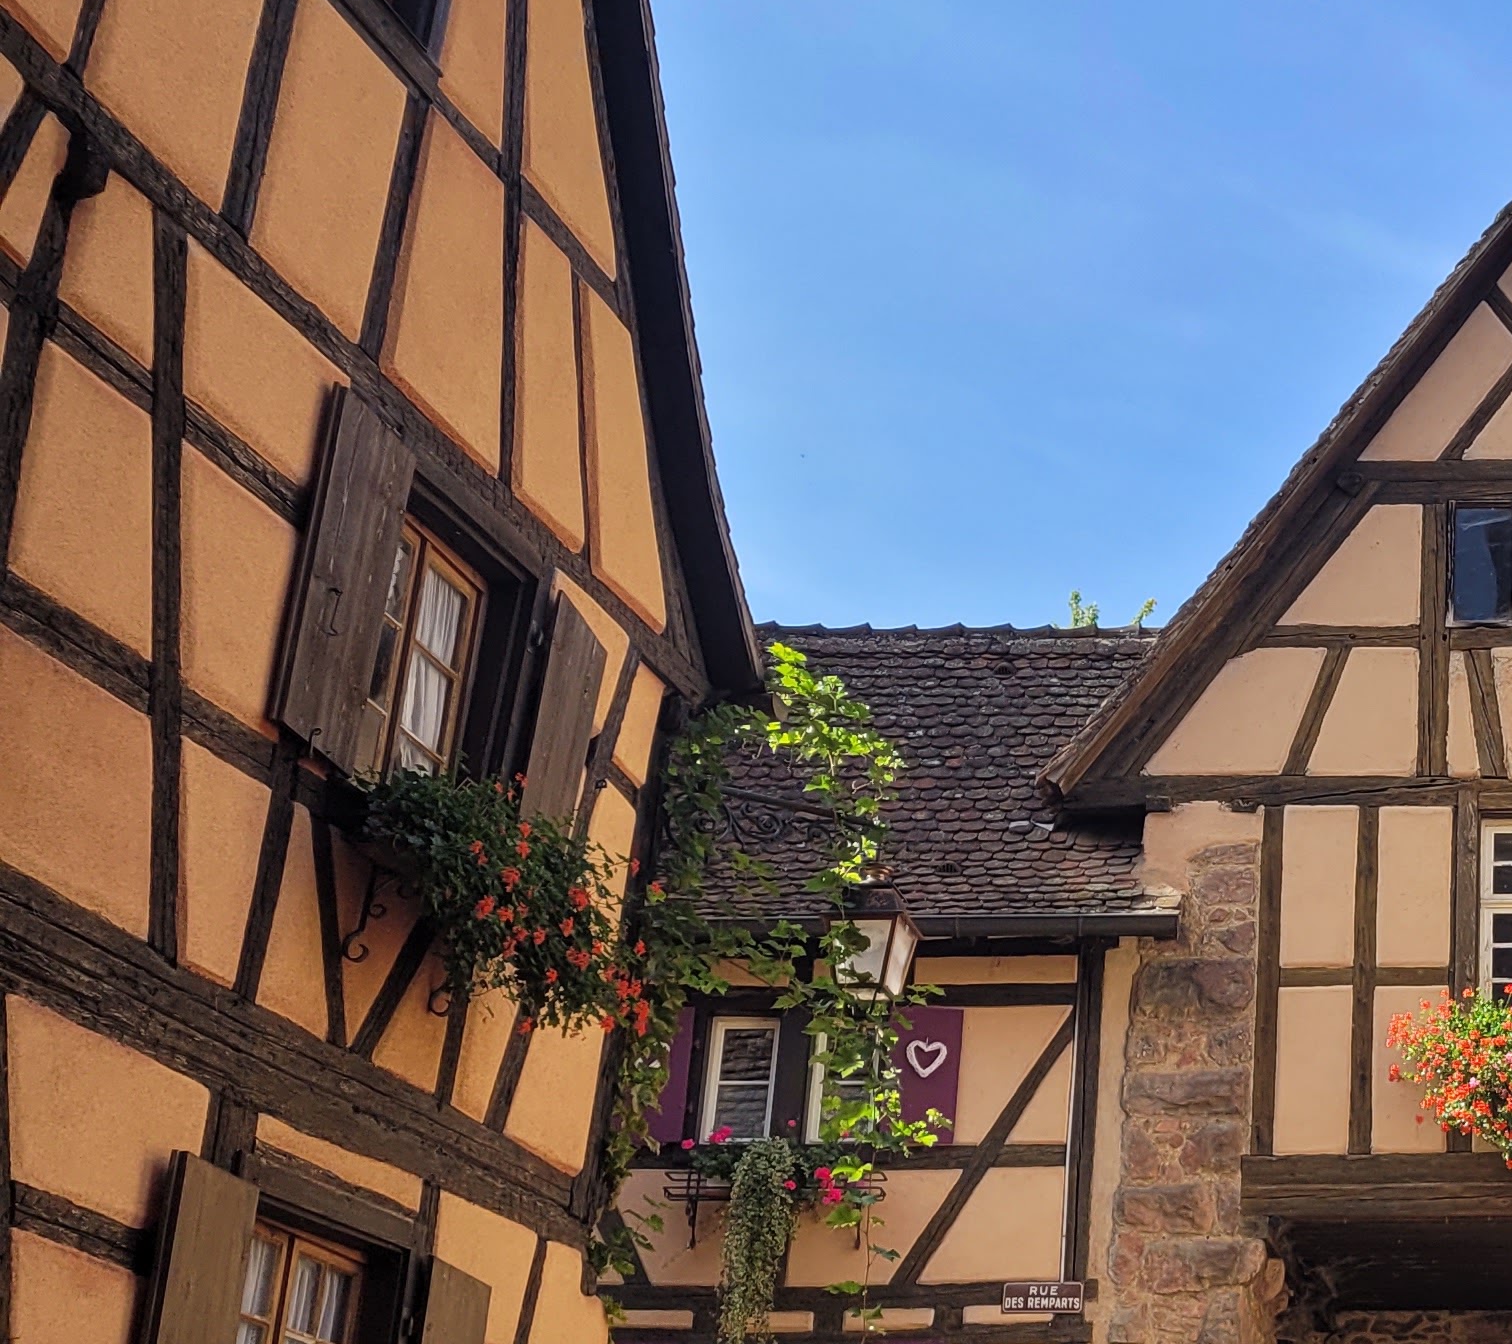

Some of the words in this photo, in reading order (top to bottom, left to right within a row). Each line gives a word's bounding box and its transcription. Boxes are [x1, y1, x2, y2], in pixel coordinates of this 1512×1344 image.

[1029, 1285, 1059, 1296] RUE
[1004, 1296, 1024, 1309] DES
[1027, 1296, 1080, 1309] REMPARTS
